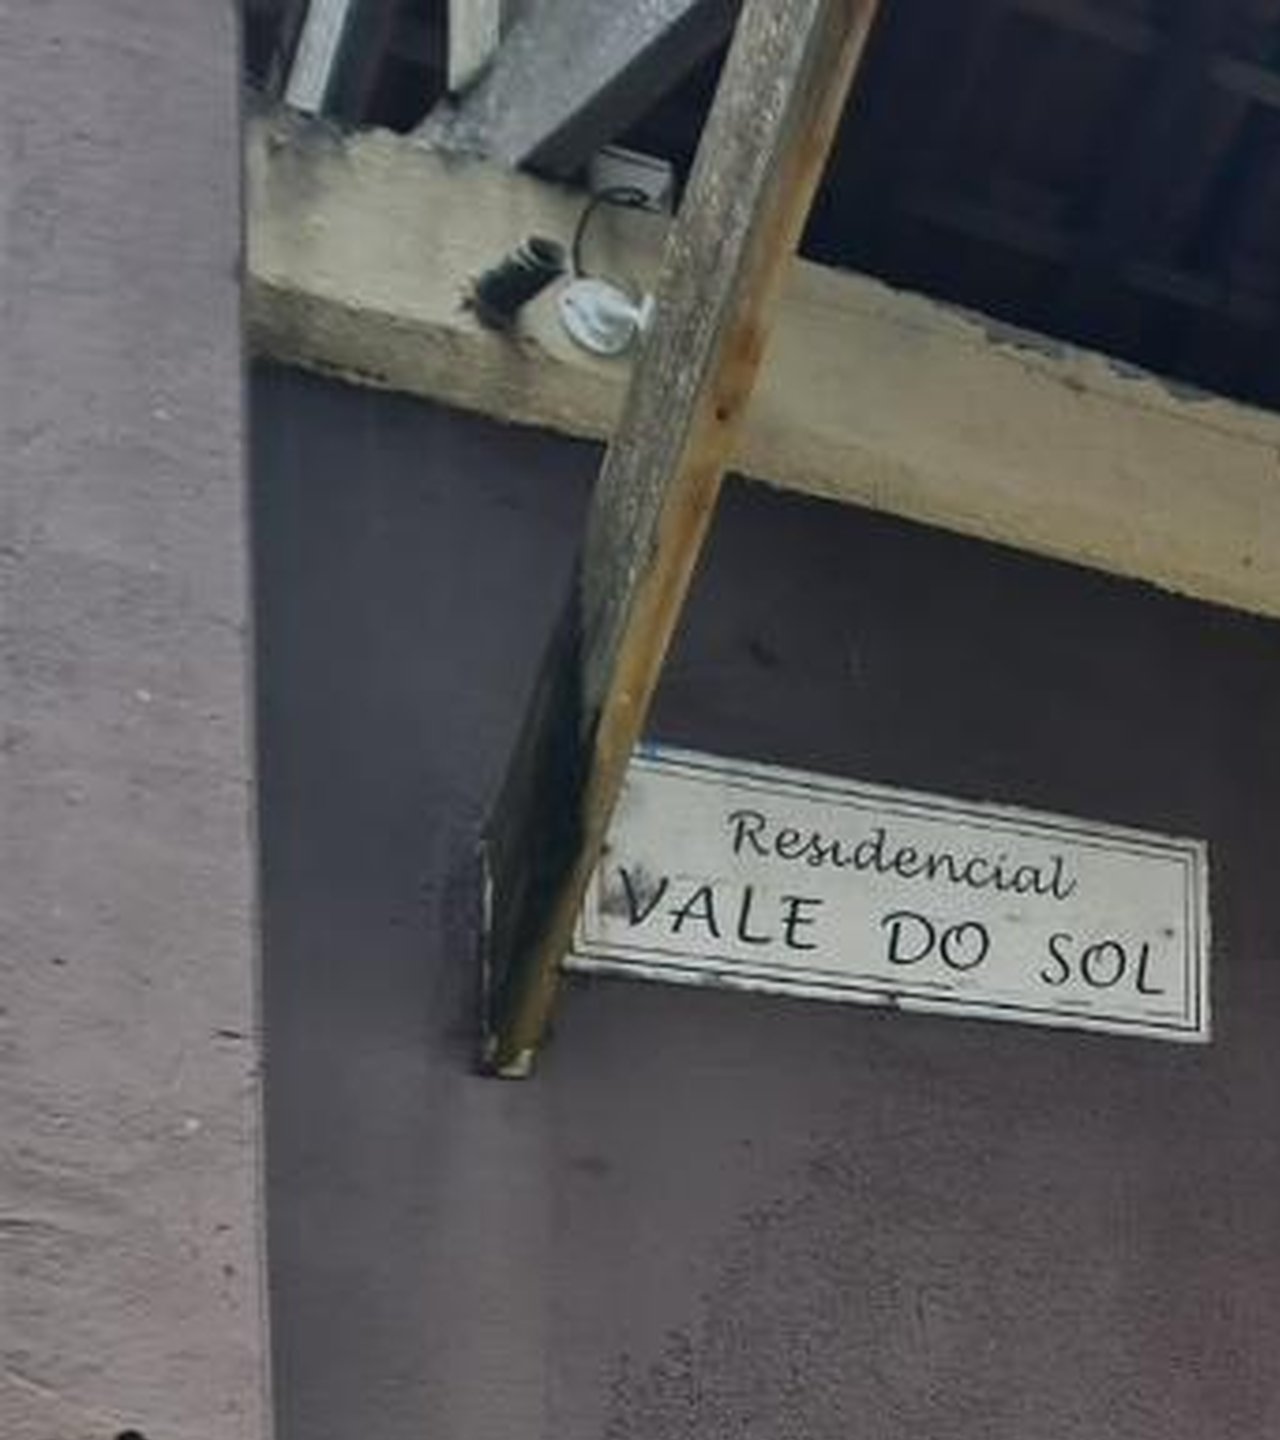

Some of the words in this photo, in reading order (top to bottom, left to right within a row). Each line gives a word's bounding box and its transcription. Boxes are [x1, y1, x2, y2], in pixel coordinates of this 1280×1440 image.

[727, 808, 1077, 901] Residencial
[617, 864, 824, 952] VALE
[880, 909, 991, 972] DO
[1038, 931, 1169, 996] SOL
